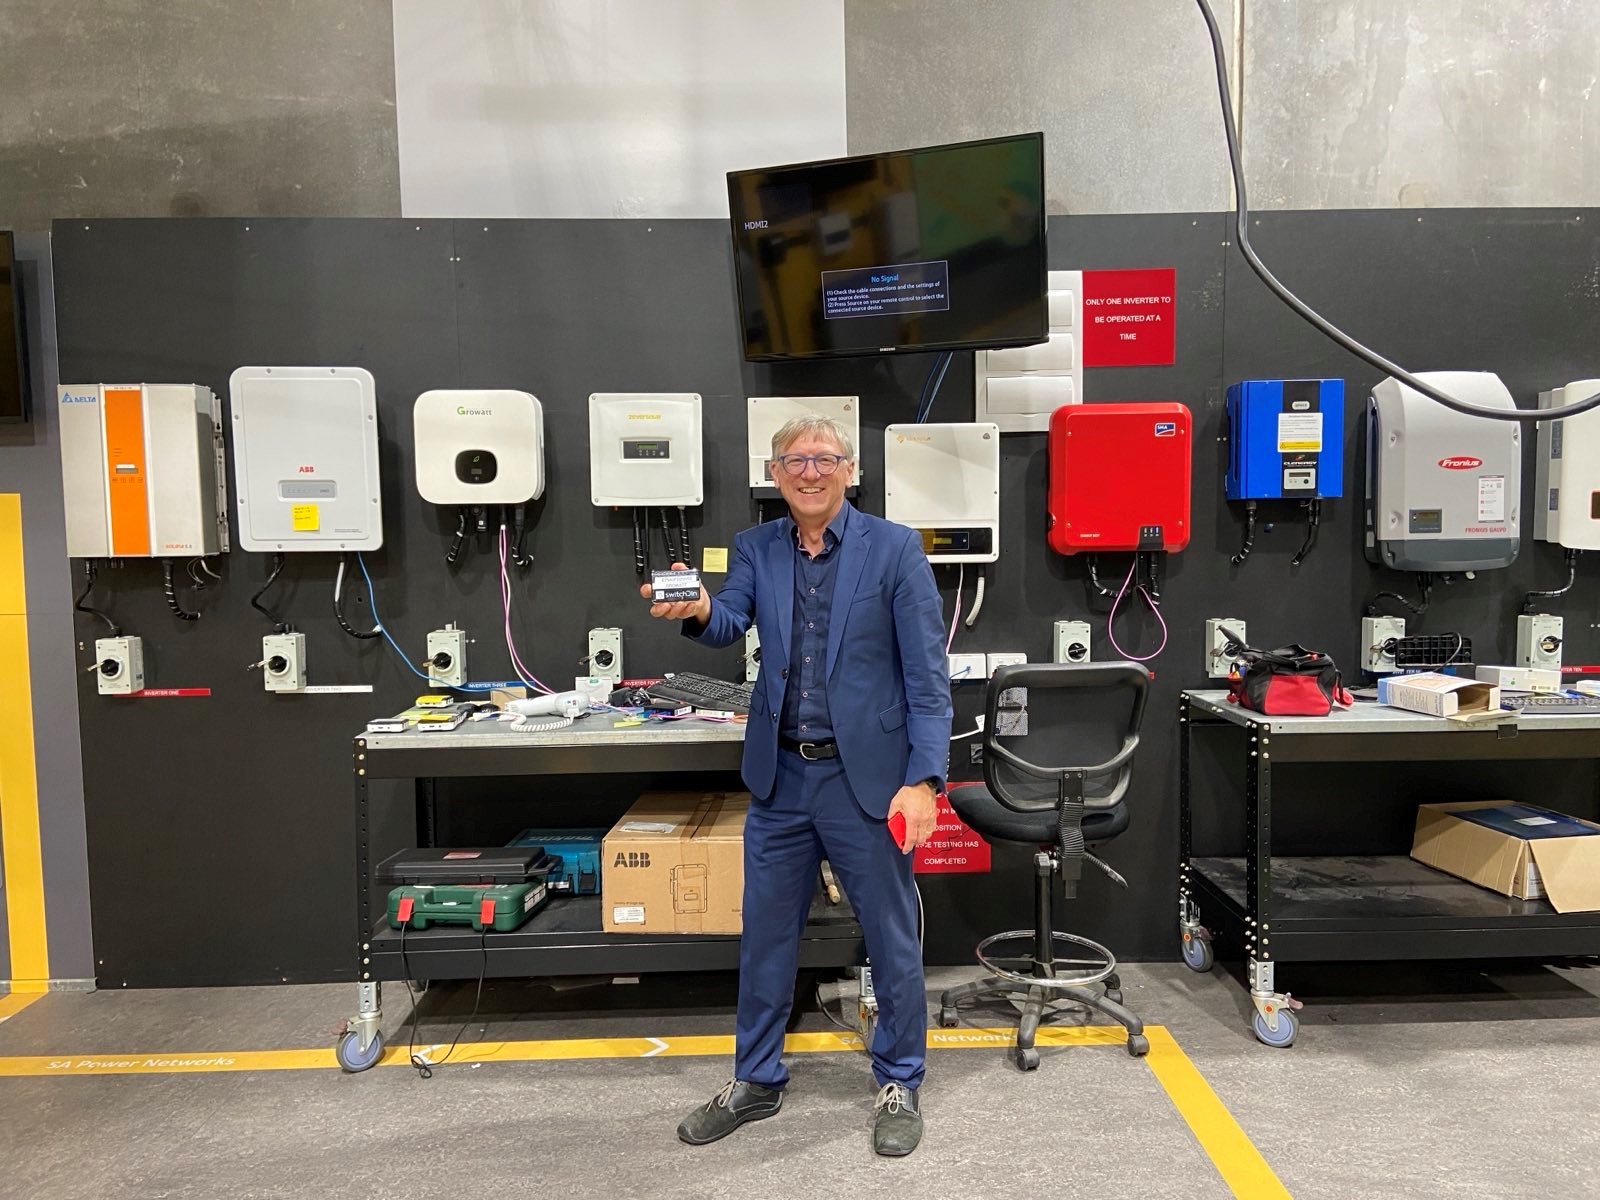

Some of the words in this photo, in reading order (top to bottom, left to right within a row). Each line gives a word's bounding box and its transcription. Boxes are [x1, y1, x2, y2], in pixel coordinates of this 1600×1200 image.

[744, 220, 769, 230] HDMI2
[880, 273, 899, 284] Signal
[1085, 298, 1105, 306] ONLY
[1105, 297, 1122, 305] ONE
[1123, 296, 1160, 305] INVERTER
[1160, 296, 1171, 304] TO
[1105, 315, 1145, 323] OPERATED
[1145, 314, 1155, 322] AT
[456, 406, 492, 416] Growatt
[1441, 459, 1480, 467] Fronius
[964, 840, 979, 848] HAS
[613, 852, 651, 868] ABB
[924, 857, 967, 865] COMPLETED
[45, 1060, 71, 1069] SA
[76, 1059, 140, 1069] Power
[142, 1057, 235, 1067] Networks
